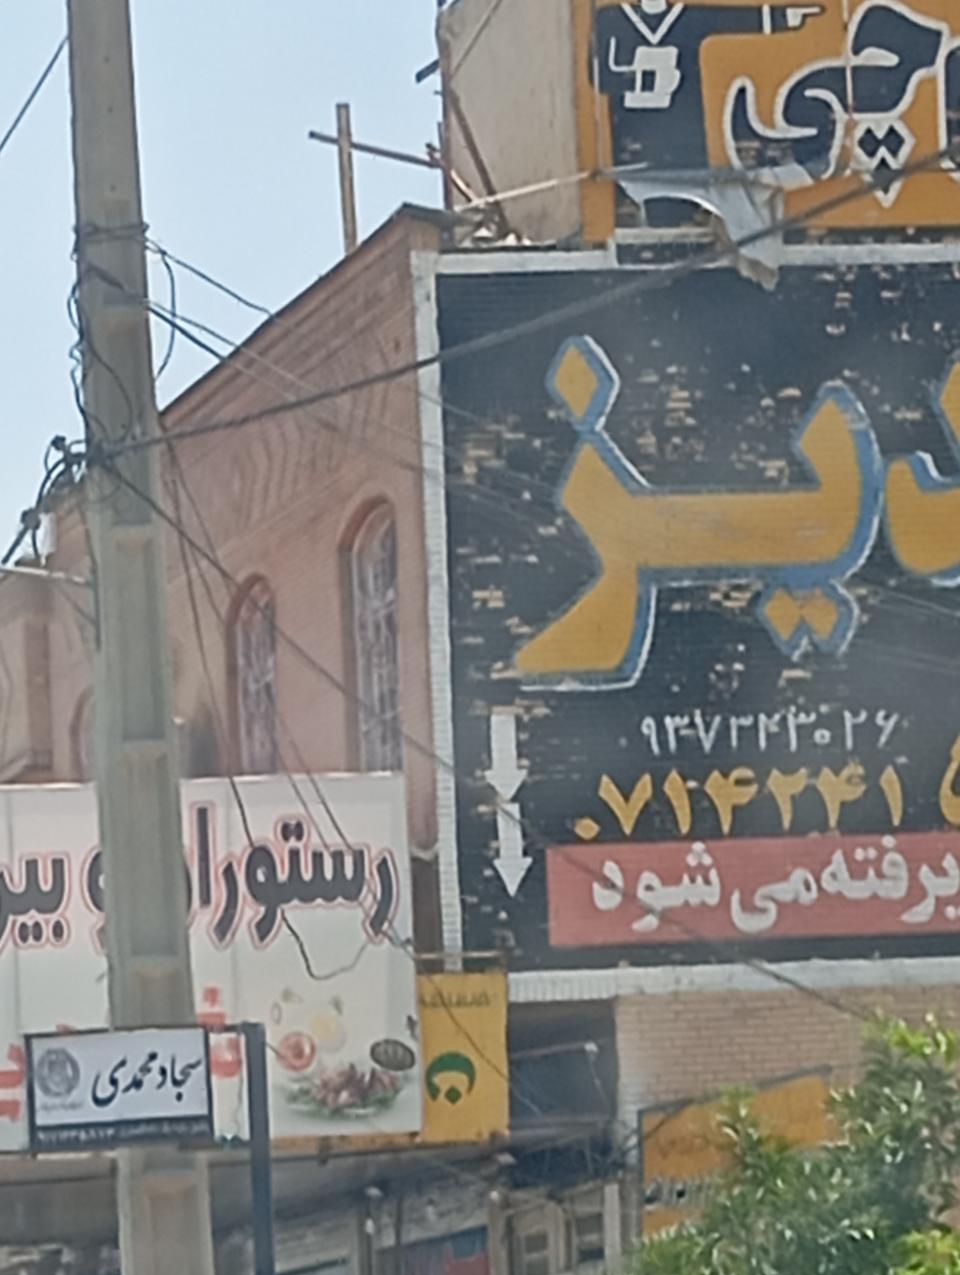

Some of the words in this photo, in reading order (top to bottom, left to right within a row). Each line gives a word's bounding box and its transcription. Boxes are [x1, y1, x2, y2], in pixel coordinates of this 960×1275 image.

[187, 803, 398, 950] رستورا
[593, 841, 721, 932] شود
[92, 1051, 159, 1108] محمدی
